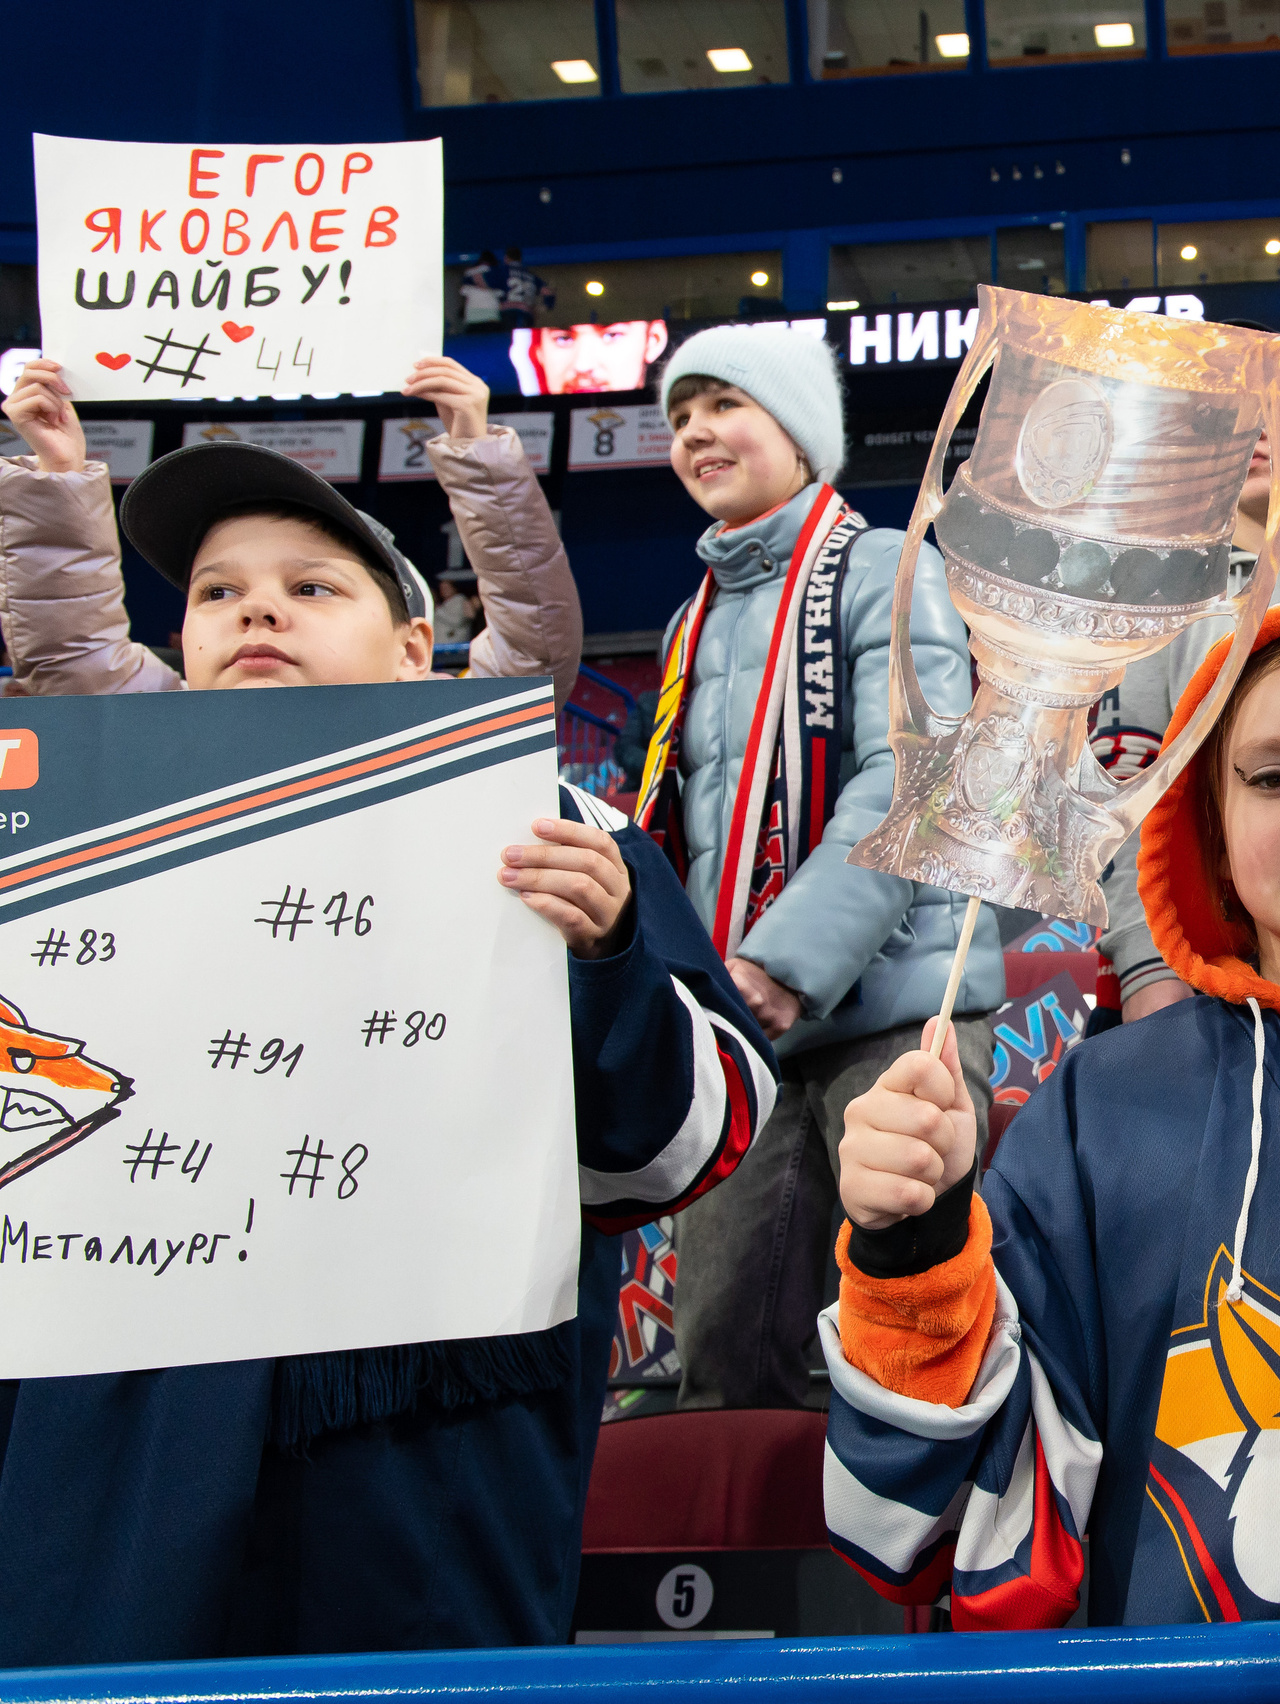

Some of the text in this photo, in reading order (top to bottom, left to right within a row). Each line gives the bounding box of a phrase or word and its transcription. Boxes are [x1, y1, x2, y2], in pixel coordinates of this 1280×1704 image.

[188, 148, 374, 200] ЕГОР
[84, 205, 400, 256] ЯКОВЛЕВ
[74, 259, 353, 311] ШАЙБУ!
[254, 884, 375, 942] #76
[30, 927, 117, 968] #83
[207, 1029, 304, 1078] #91
[361, 1009, 447, 1048] #80
[123, 1127, 213, 1183] #4
[280, 1134, 369, 1200] #8
[673, 1574, 695, 1618] 5
